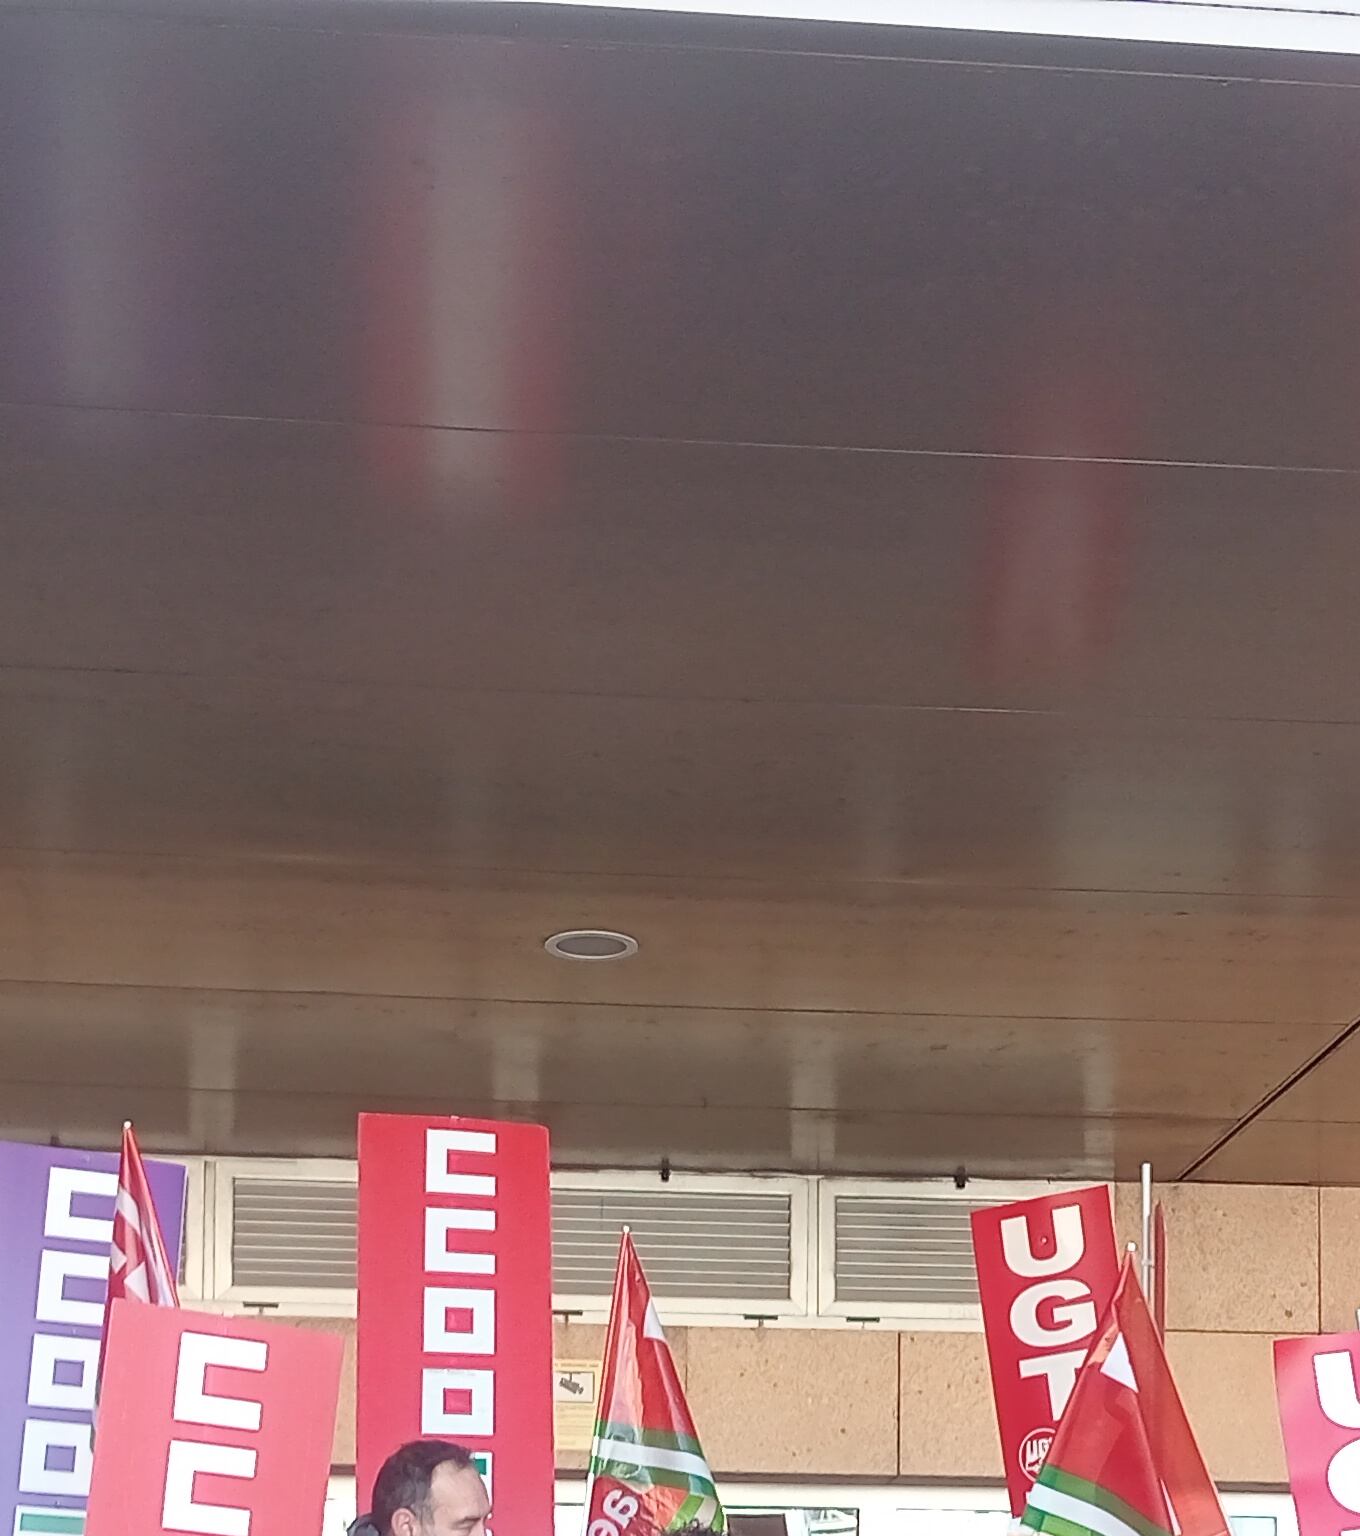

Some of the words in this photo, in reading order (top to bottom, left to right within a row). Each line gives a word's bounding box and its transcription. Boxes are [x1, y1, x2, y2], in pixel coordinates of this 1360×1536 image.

[18, 1166, 119, 1497] CCOO
[421, 1128, 497, 1436] CCOO
[1000, 1205, 1097, 1421] UGT
